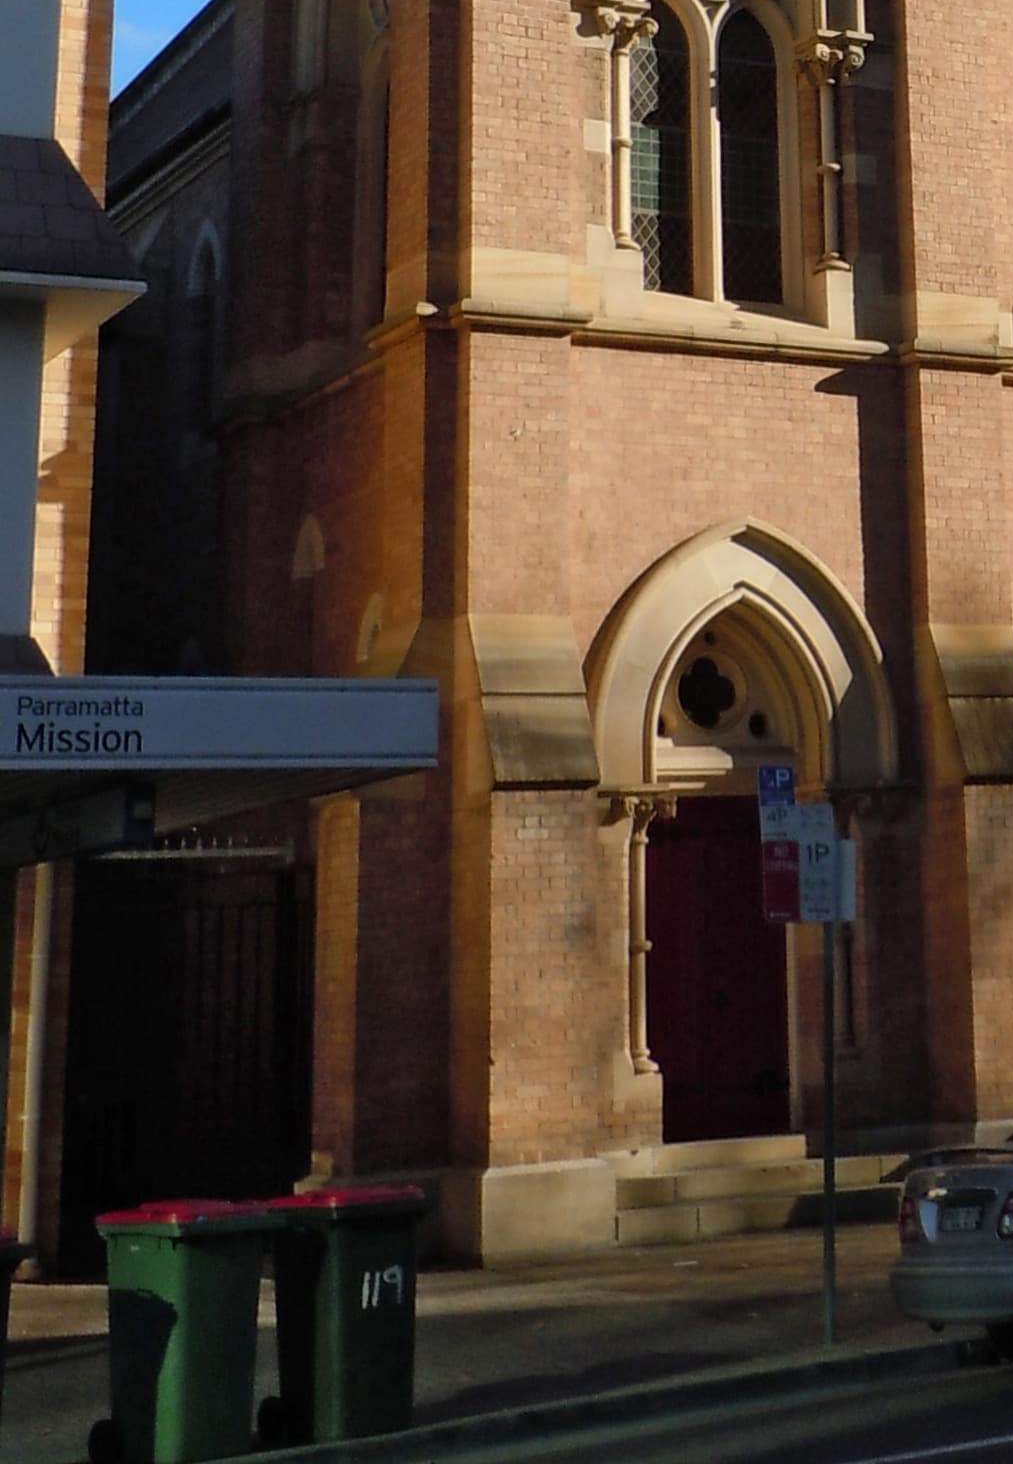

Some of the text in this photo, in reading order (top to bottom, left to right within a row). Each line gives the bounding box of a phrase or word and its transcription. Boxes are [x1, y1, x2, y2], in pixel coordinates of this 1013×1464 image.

[16, 696, 144, 716] Parramatta
[15, 722, 143, 753] Mission
[806, 842, 830, 864] 1P
[361, 1264, 402, 1310] 119
